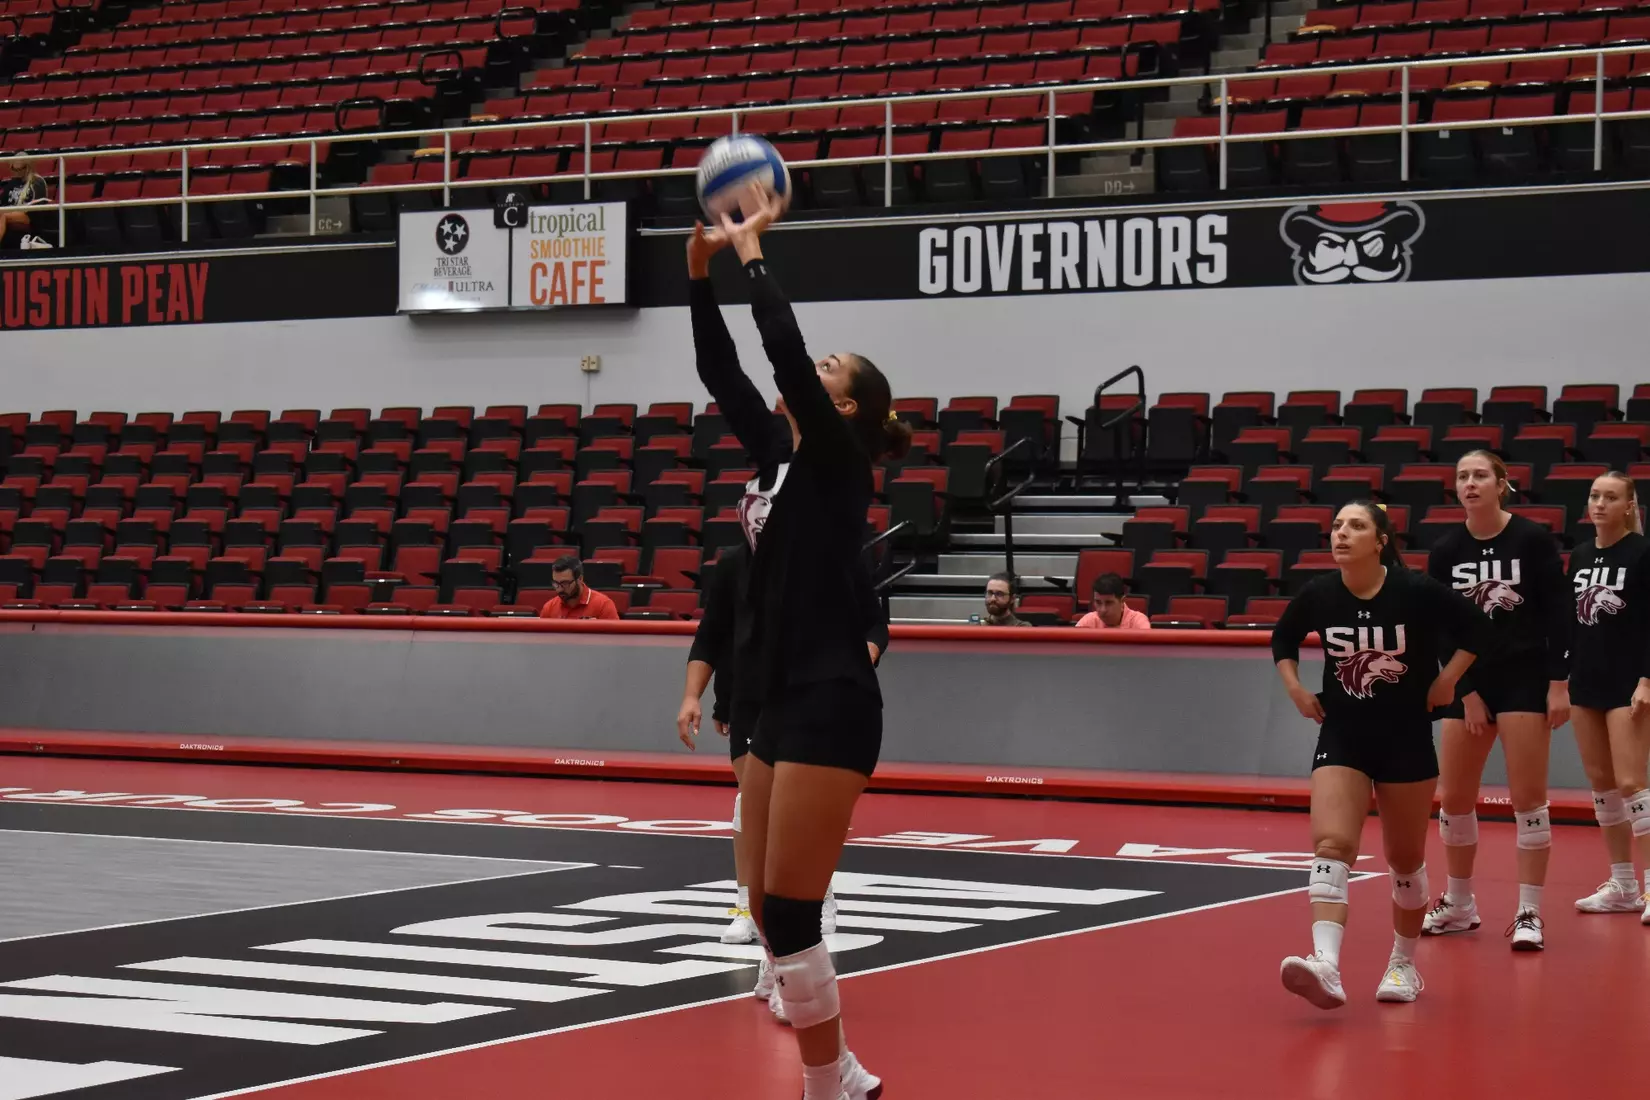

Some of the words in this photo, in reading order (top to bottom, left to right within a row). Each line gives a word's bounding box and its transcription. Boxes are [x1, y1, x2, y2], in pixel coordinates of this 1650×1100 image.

[503, 206, 519, 226] C
[529, 206, 606, 238] tropical
[530, 236, 606, 260] SMOOTHIE
[918, 214, 1228, 295] GOVERNORS
[433, 266, 472, 277] BEVERAGE
[450, 256, 469, 266] STAR
[0, 267, 109, 328] USTIN
[120, 262, 209, 324] PEAY
[455, 281, 494, 293] ULTRA
[530, 260, 606, 305] CAFE
[1451, 558, 1521, 590] SIU
[1573, 566, 1627, 593] SIU
[1325, 624, 1406, 658] SIU
[179, 743, 224, 751] DAKTRONICS
[554, 758, 605, 767] DAKTRONICS
[985, 775, 1044, 785] DAKTRONICS
[403, 808, 853, 835] OOS
